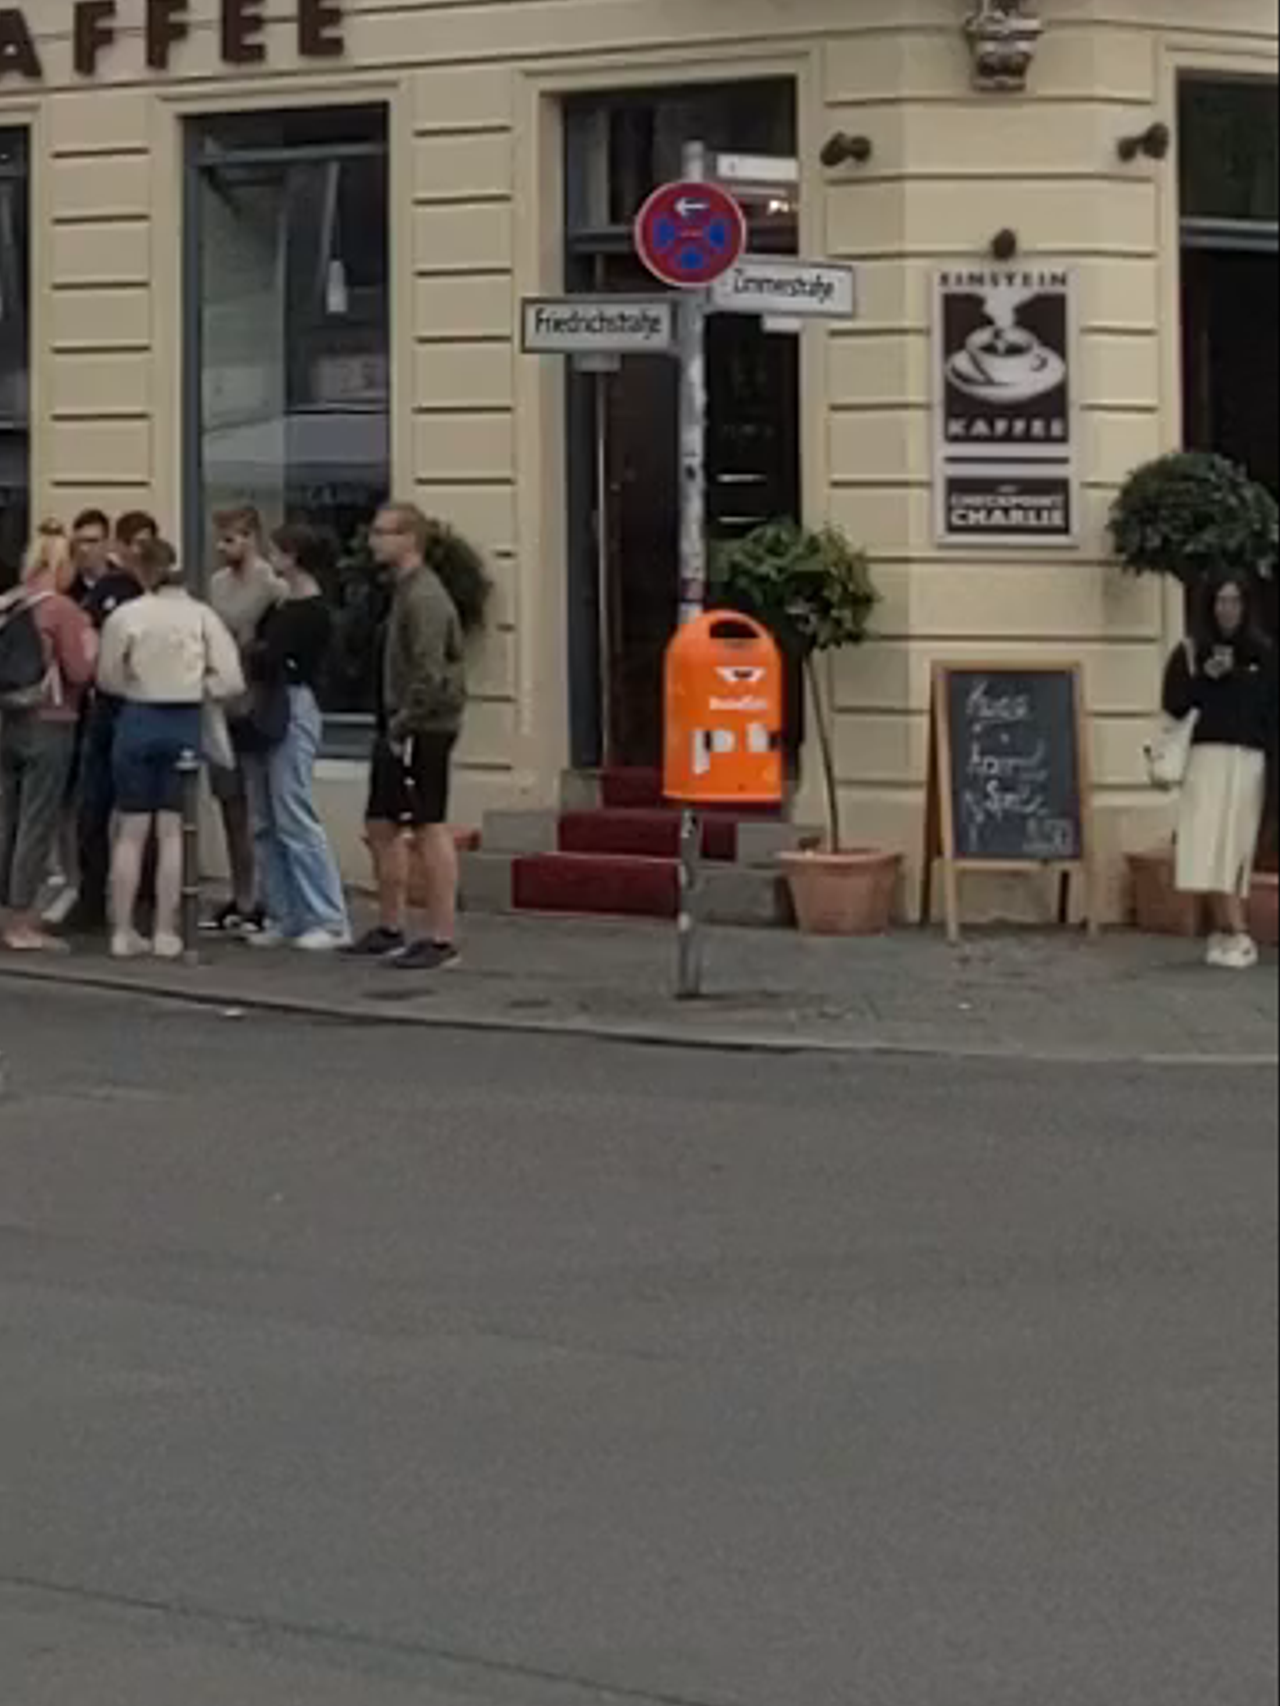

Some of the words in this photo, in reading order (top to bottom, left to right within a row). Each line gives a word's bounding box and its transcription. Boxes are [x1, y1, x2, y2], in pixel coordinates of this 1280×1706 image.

[941, 270, 1068, 288] EINSTEIN
[535, 306, 662, 341] Friedrichstraße
[947, 416, 1065, 438] KAFFEE
[951, 509, 1064, 526] CHARLIE
